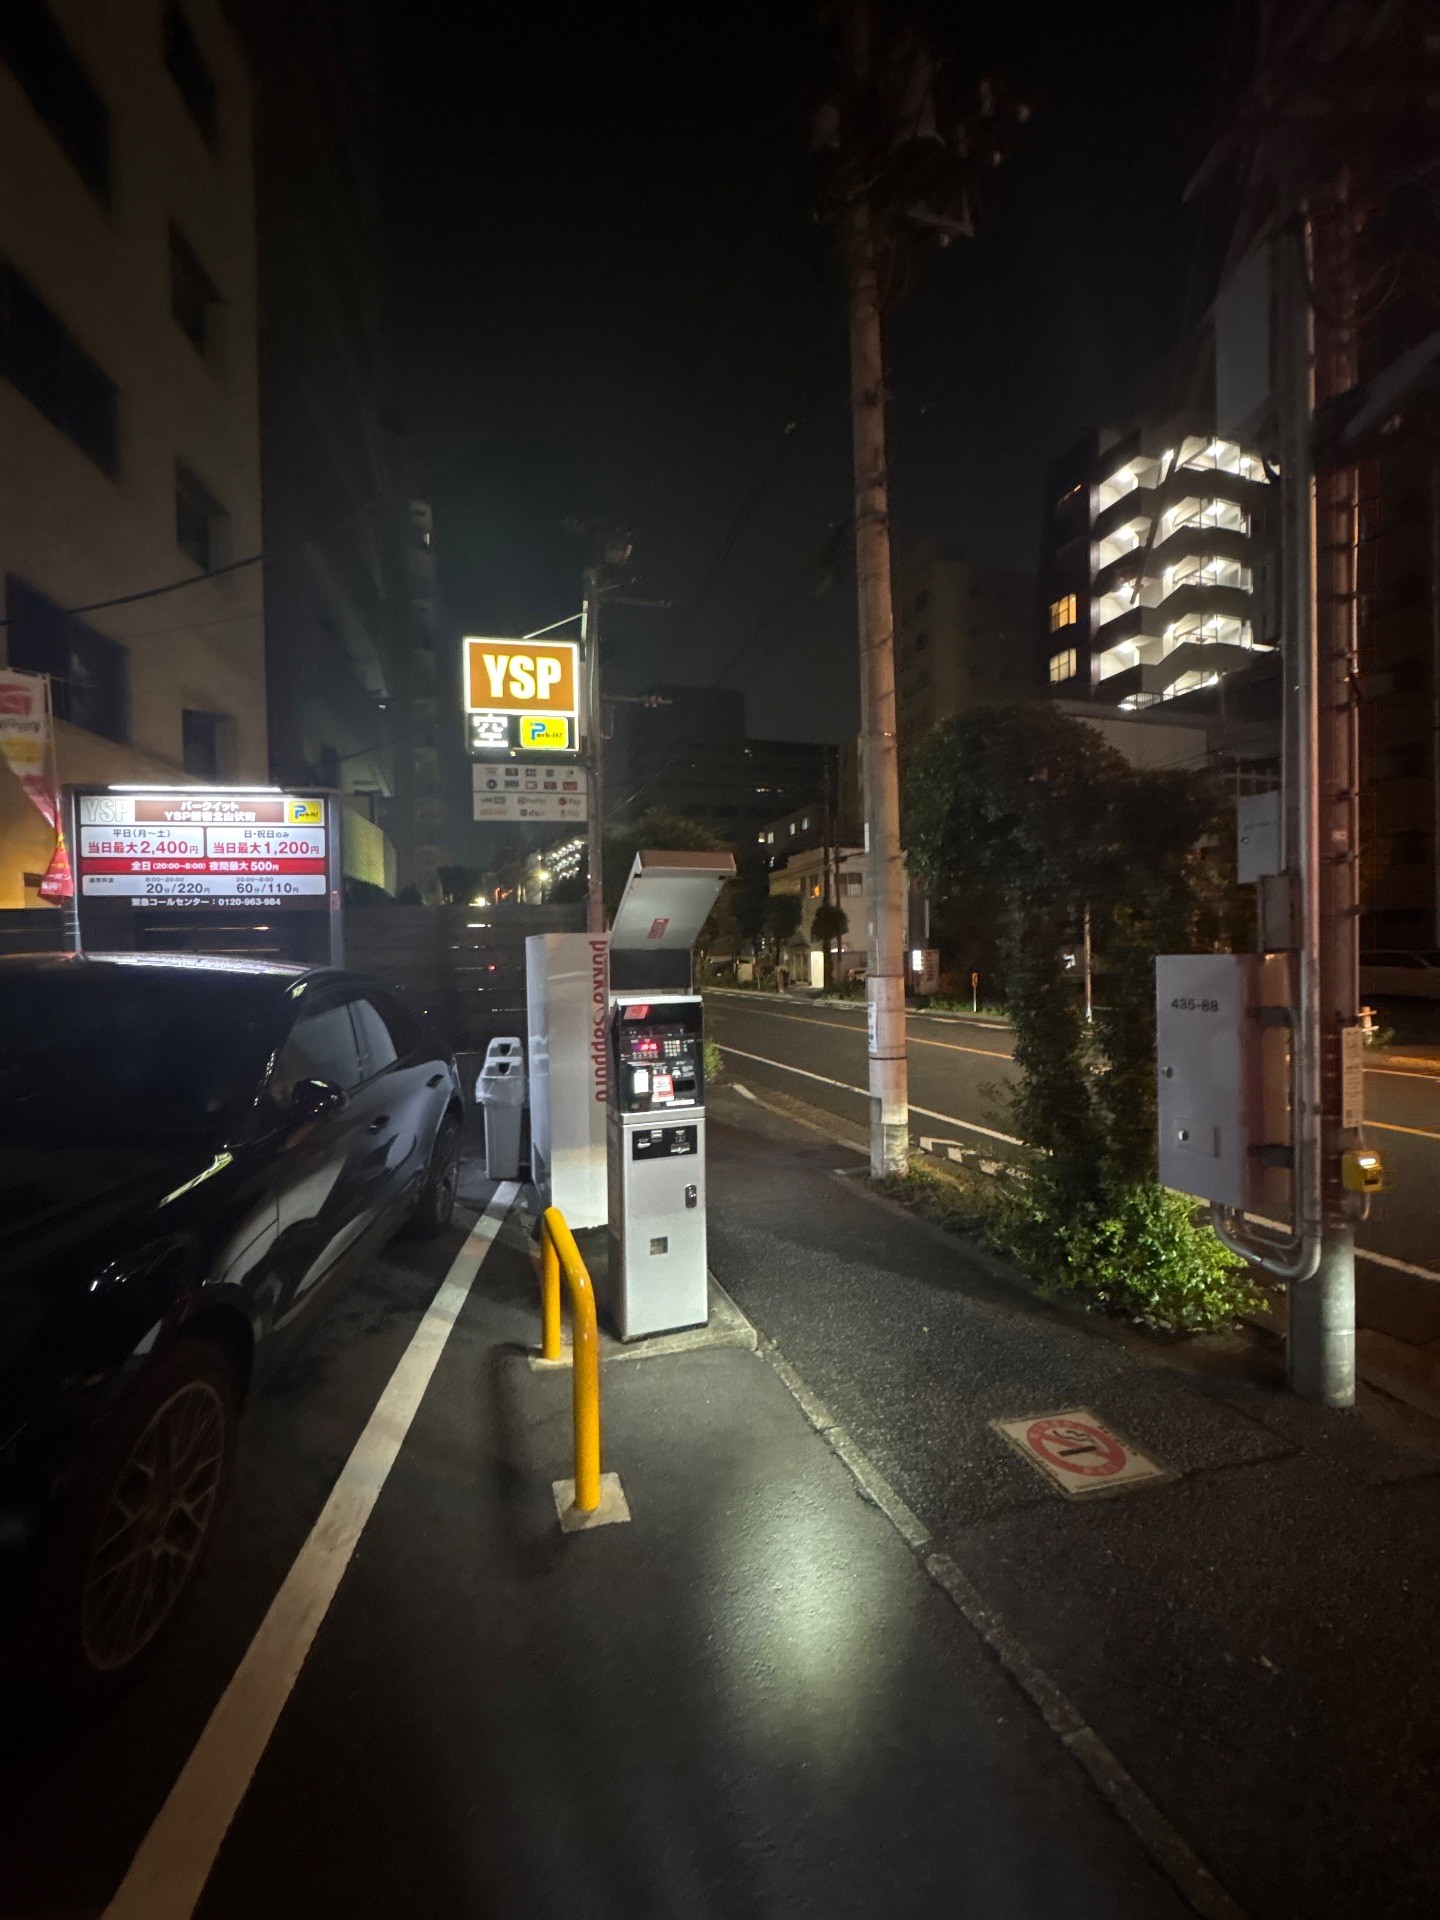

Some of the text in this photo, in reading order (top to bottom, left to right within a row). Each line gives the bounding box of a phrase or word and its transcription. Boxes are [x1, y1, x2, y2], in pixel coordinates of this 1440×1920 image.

[482, 654, 562, 700] YSP
[472, 713, 508, 748] 空
[86, 797, 129, 823] YSP
[87, 840, 199, 856] 当日最大2,400円
[213, 841, 320, 856] 当日最大1,200円
[1171, 998, 1219, 1012] 435-88
